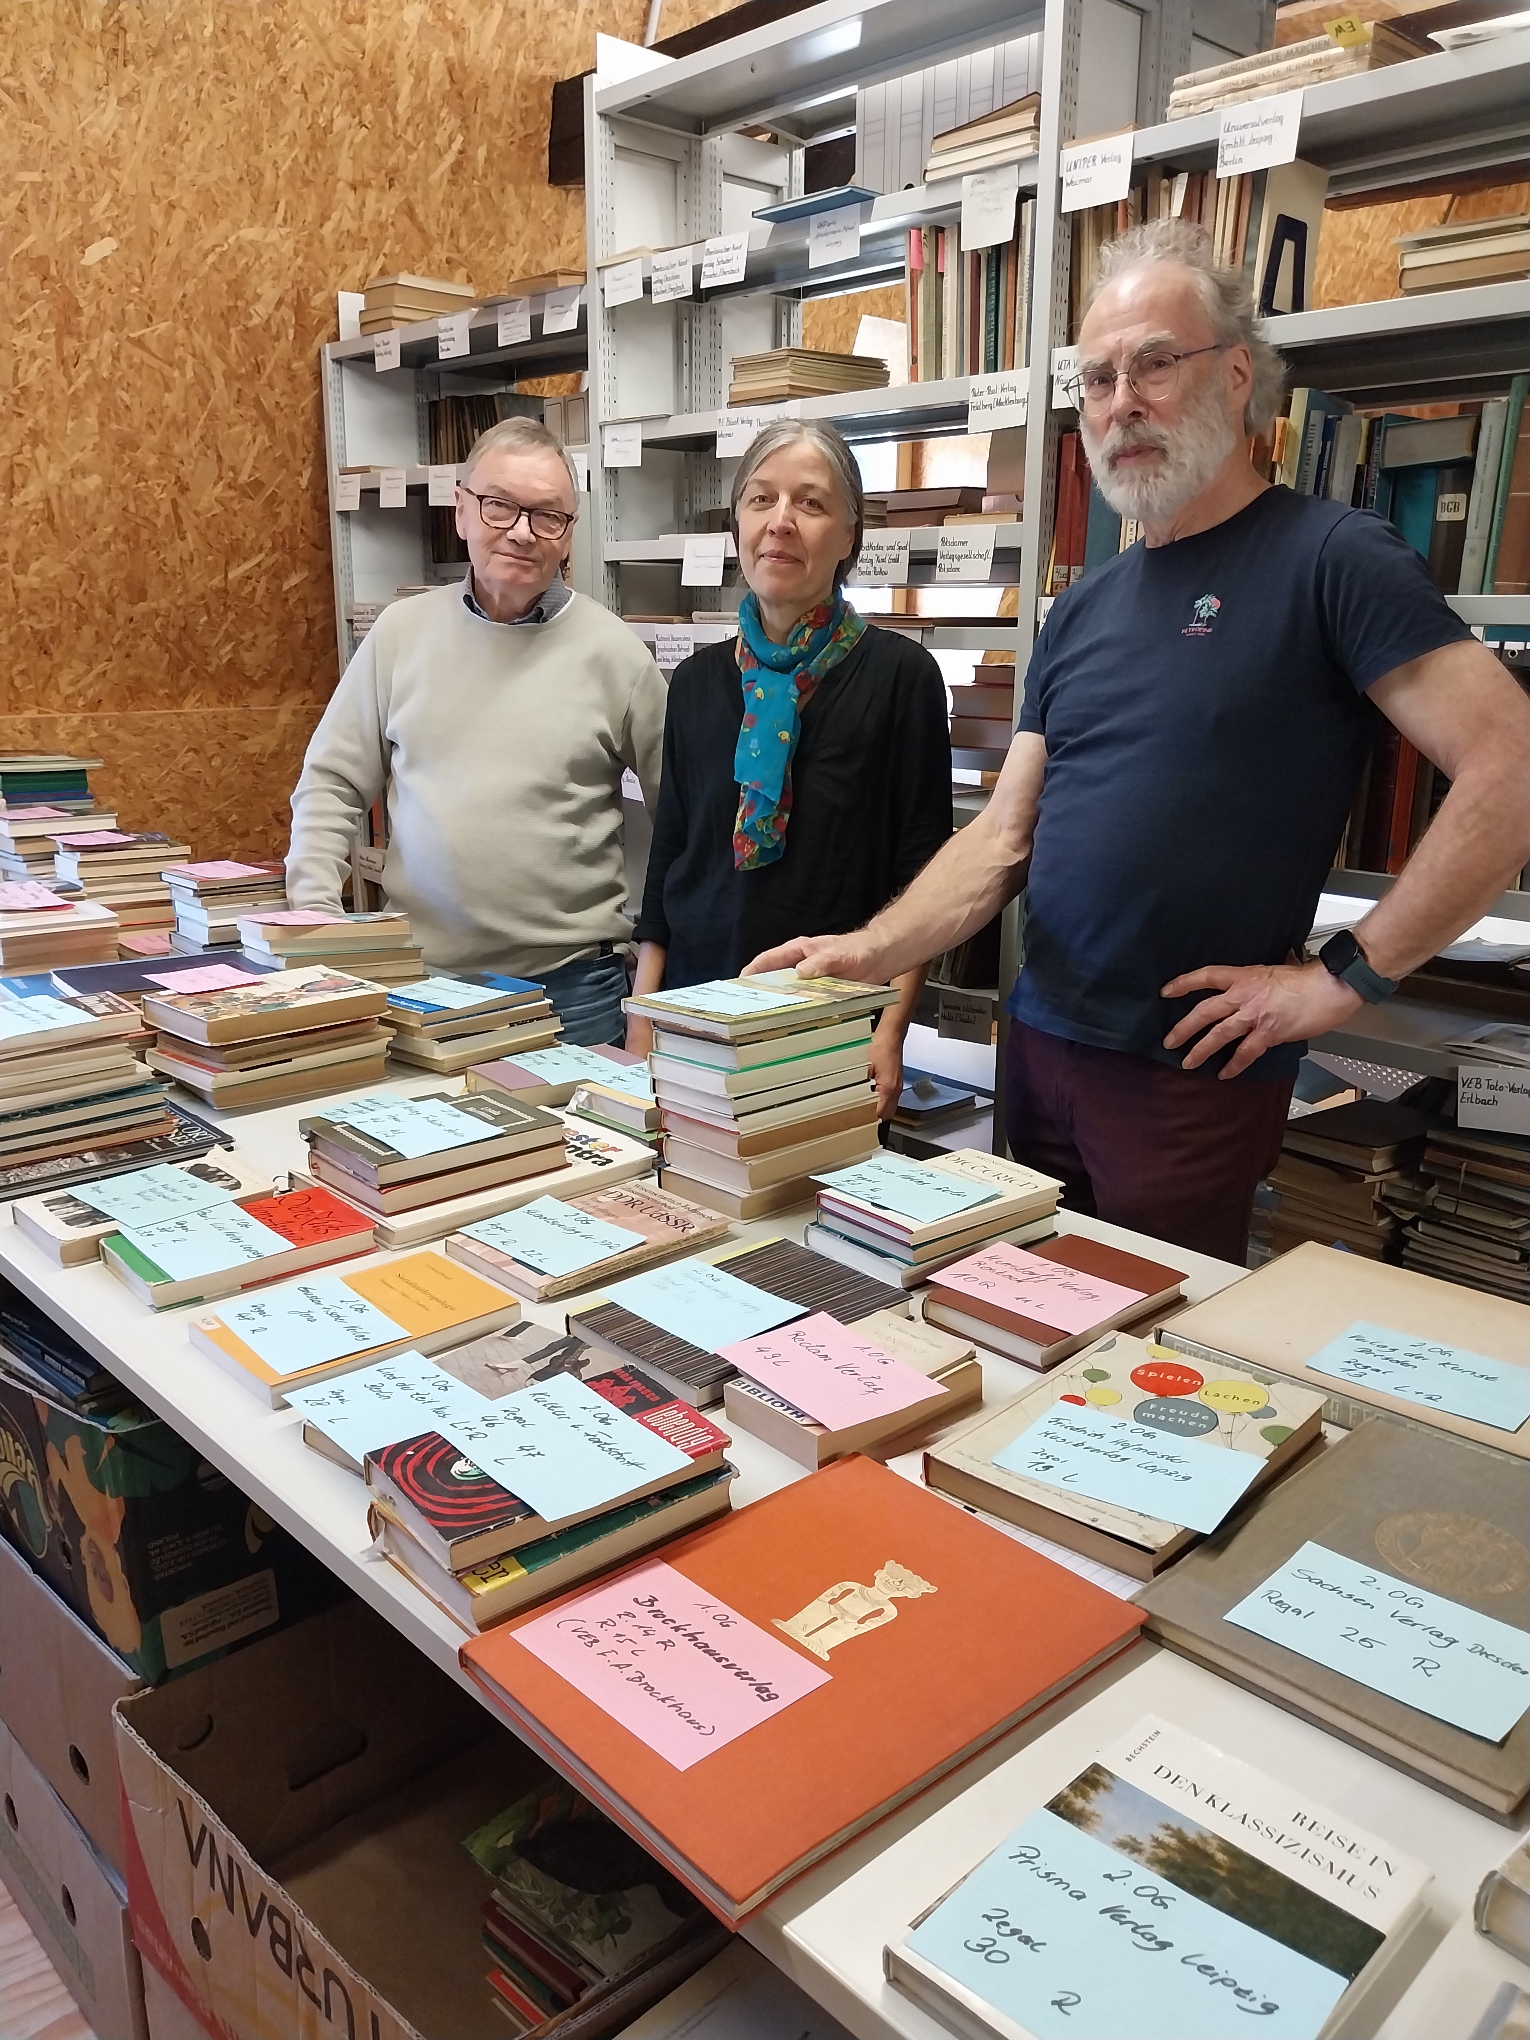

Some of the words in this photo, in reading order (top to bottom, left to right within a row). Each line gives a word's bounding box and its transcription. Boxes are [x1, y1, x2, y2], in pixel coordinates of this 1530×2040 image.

[1219, 52, 1282, 75] AUSGEWÄHLTE
[1285, 38, 1330, 59] MÄRCHEN
[1223, 111, 1284, 134] Universalverlag
[1101, 152, 1121, 164] Verlag
[1440, 501, 1460, 514] BGB
[1461, 1077, 1482, 1089] VEB
[1460, 1092, 1498, 1106] Erlbach
[182, 1126, 220, 1141] ORT
[603, 1190, 644, 1209] DDR
[639, 1205, 696, 1233] UdSSR
[250, 1303, 273, 1317] Regal
[287, 1309, 318, 1323] Jena
[321, 1305, 348, 1323] Fischer
[343, 1325, 370, 1341] Verlag
[787, 1330, 832, 1362] Reclam
[834, 1362, 884, 1396] Verlag
[1342, 1359, 1395, 1376] Regal
[1348, 1334, 1400, 1354] Verlag
[1403, 1350, 1430, 1361] der
[1438, 1361, 1500, 1383] Kunst
[1353, 1347, 1418, 1370] Dresden
[1135, 1367, 1203, 1388] Spielen
[363, 1382, 394, 1400] Berlin
[410, 1392, 440, 1405] Zeit
[731, 1379, 806, 1421] BIBLIOTH
[1203, 1389, 1262, 1406] Lachen
[500, 1406, 535, 1428] Regal
[1140, 1411, 1208, 1430] machen
[1149, 1403, 1211, 1422] Freude
[480, 1415, 505, 1428] 46
[516, 1444, 545, 1458] 47
[529, 1391, 571, 1421] Kultur
[583, 1430, 648, 1471] Fortschritt
[1047, 1417, 1104, 1440] Friedrich
[1109, 1436, 1191, 1465] Hofmeister
[493, 1456, 516, 1466] L
[1026, 1460, 1056, 1473] 19
[1062, 1472, 1080, 1484] L
[1135, 1460, 1194, 1483] Leipzig
[148, 1533, 179, 1549] POLAND
[1259, 1589, 1315, 1620] Regal
[1290, 1568, 1375, 1610] Sachsen
[1389, 1609, 1460, 1649] Verlag
[556, 1618, 600, 1648] (VEB
[612, 1632, 637, 1646] 15
[630, 1648, 647, 1657] L
[632, 1623, 657, 1638] 14
[655, 1638, 677, 1651] R
[632, 1595, 780, 1703] Brockhausverlag
[1411, 1656, 1442, 1678] R
[1124, 1728, 1163, 1764] BECHSTEIN
[1151, 1763, 1205, 1799] DEN
[1203, 1790, 1382, 1901] KLASSIZISMUS
[1289, 1808, 1365, 1862] REISE
[1367, 1850, 1399, 1879] IN
[981, 1907, 1049, 1955] Regal
[1007, 1843, 1089, 1903] Prisma
[1098, 1904, 1175, 1952] Verlag
[1180, 1952, 1281, 2017] Leipzig
[962, 1935, 1011, 1966] 30
[1049, 1989, 1083, 2017] R
